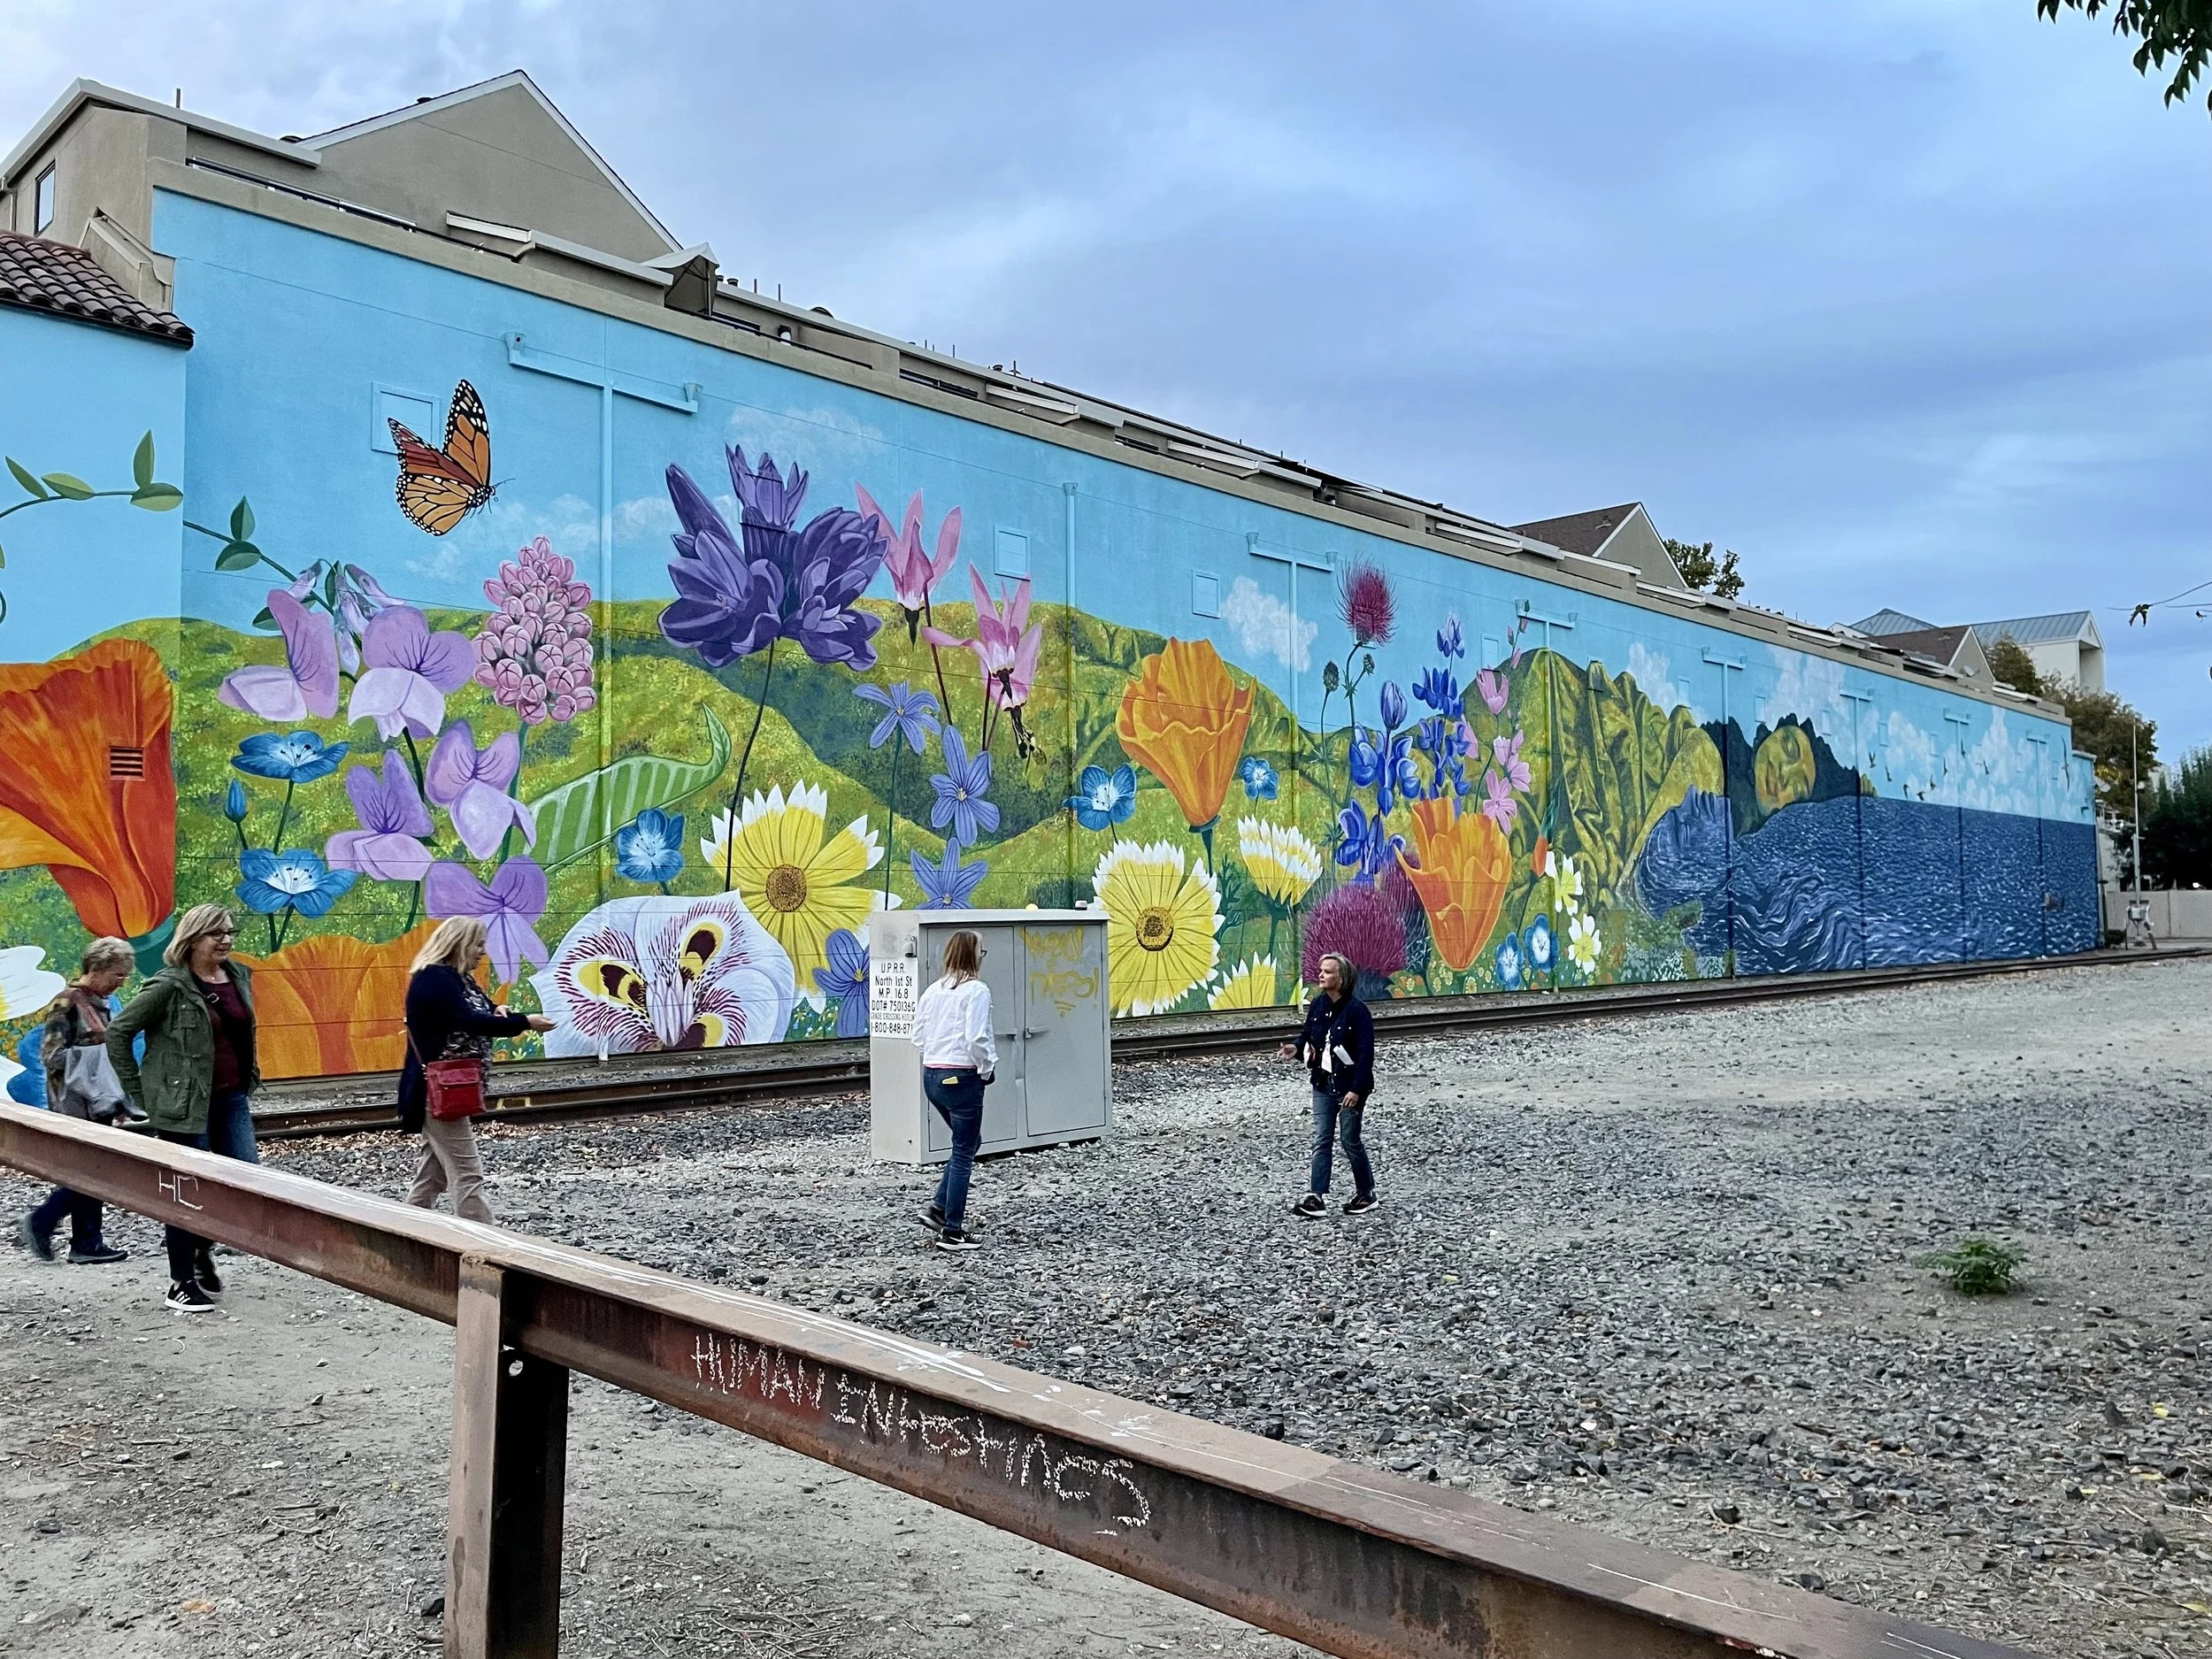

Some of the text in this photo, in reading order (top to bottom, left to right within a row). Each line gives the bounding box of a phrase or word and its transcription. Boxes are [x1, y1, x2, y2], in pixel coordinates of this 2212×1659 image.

[875, 975, 893, 987] North
[905, 976, 912, 987] St
[872, 1000, 916, 1012] DOT# 750136G
[871, 1022, 913, 1034] 1-800-848-871
[690, 1333, 826, 1410] HUMAN
